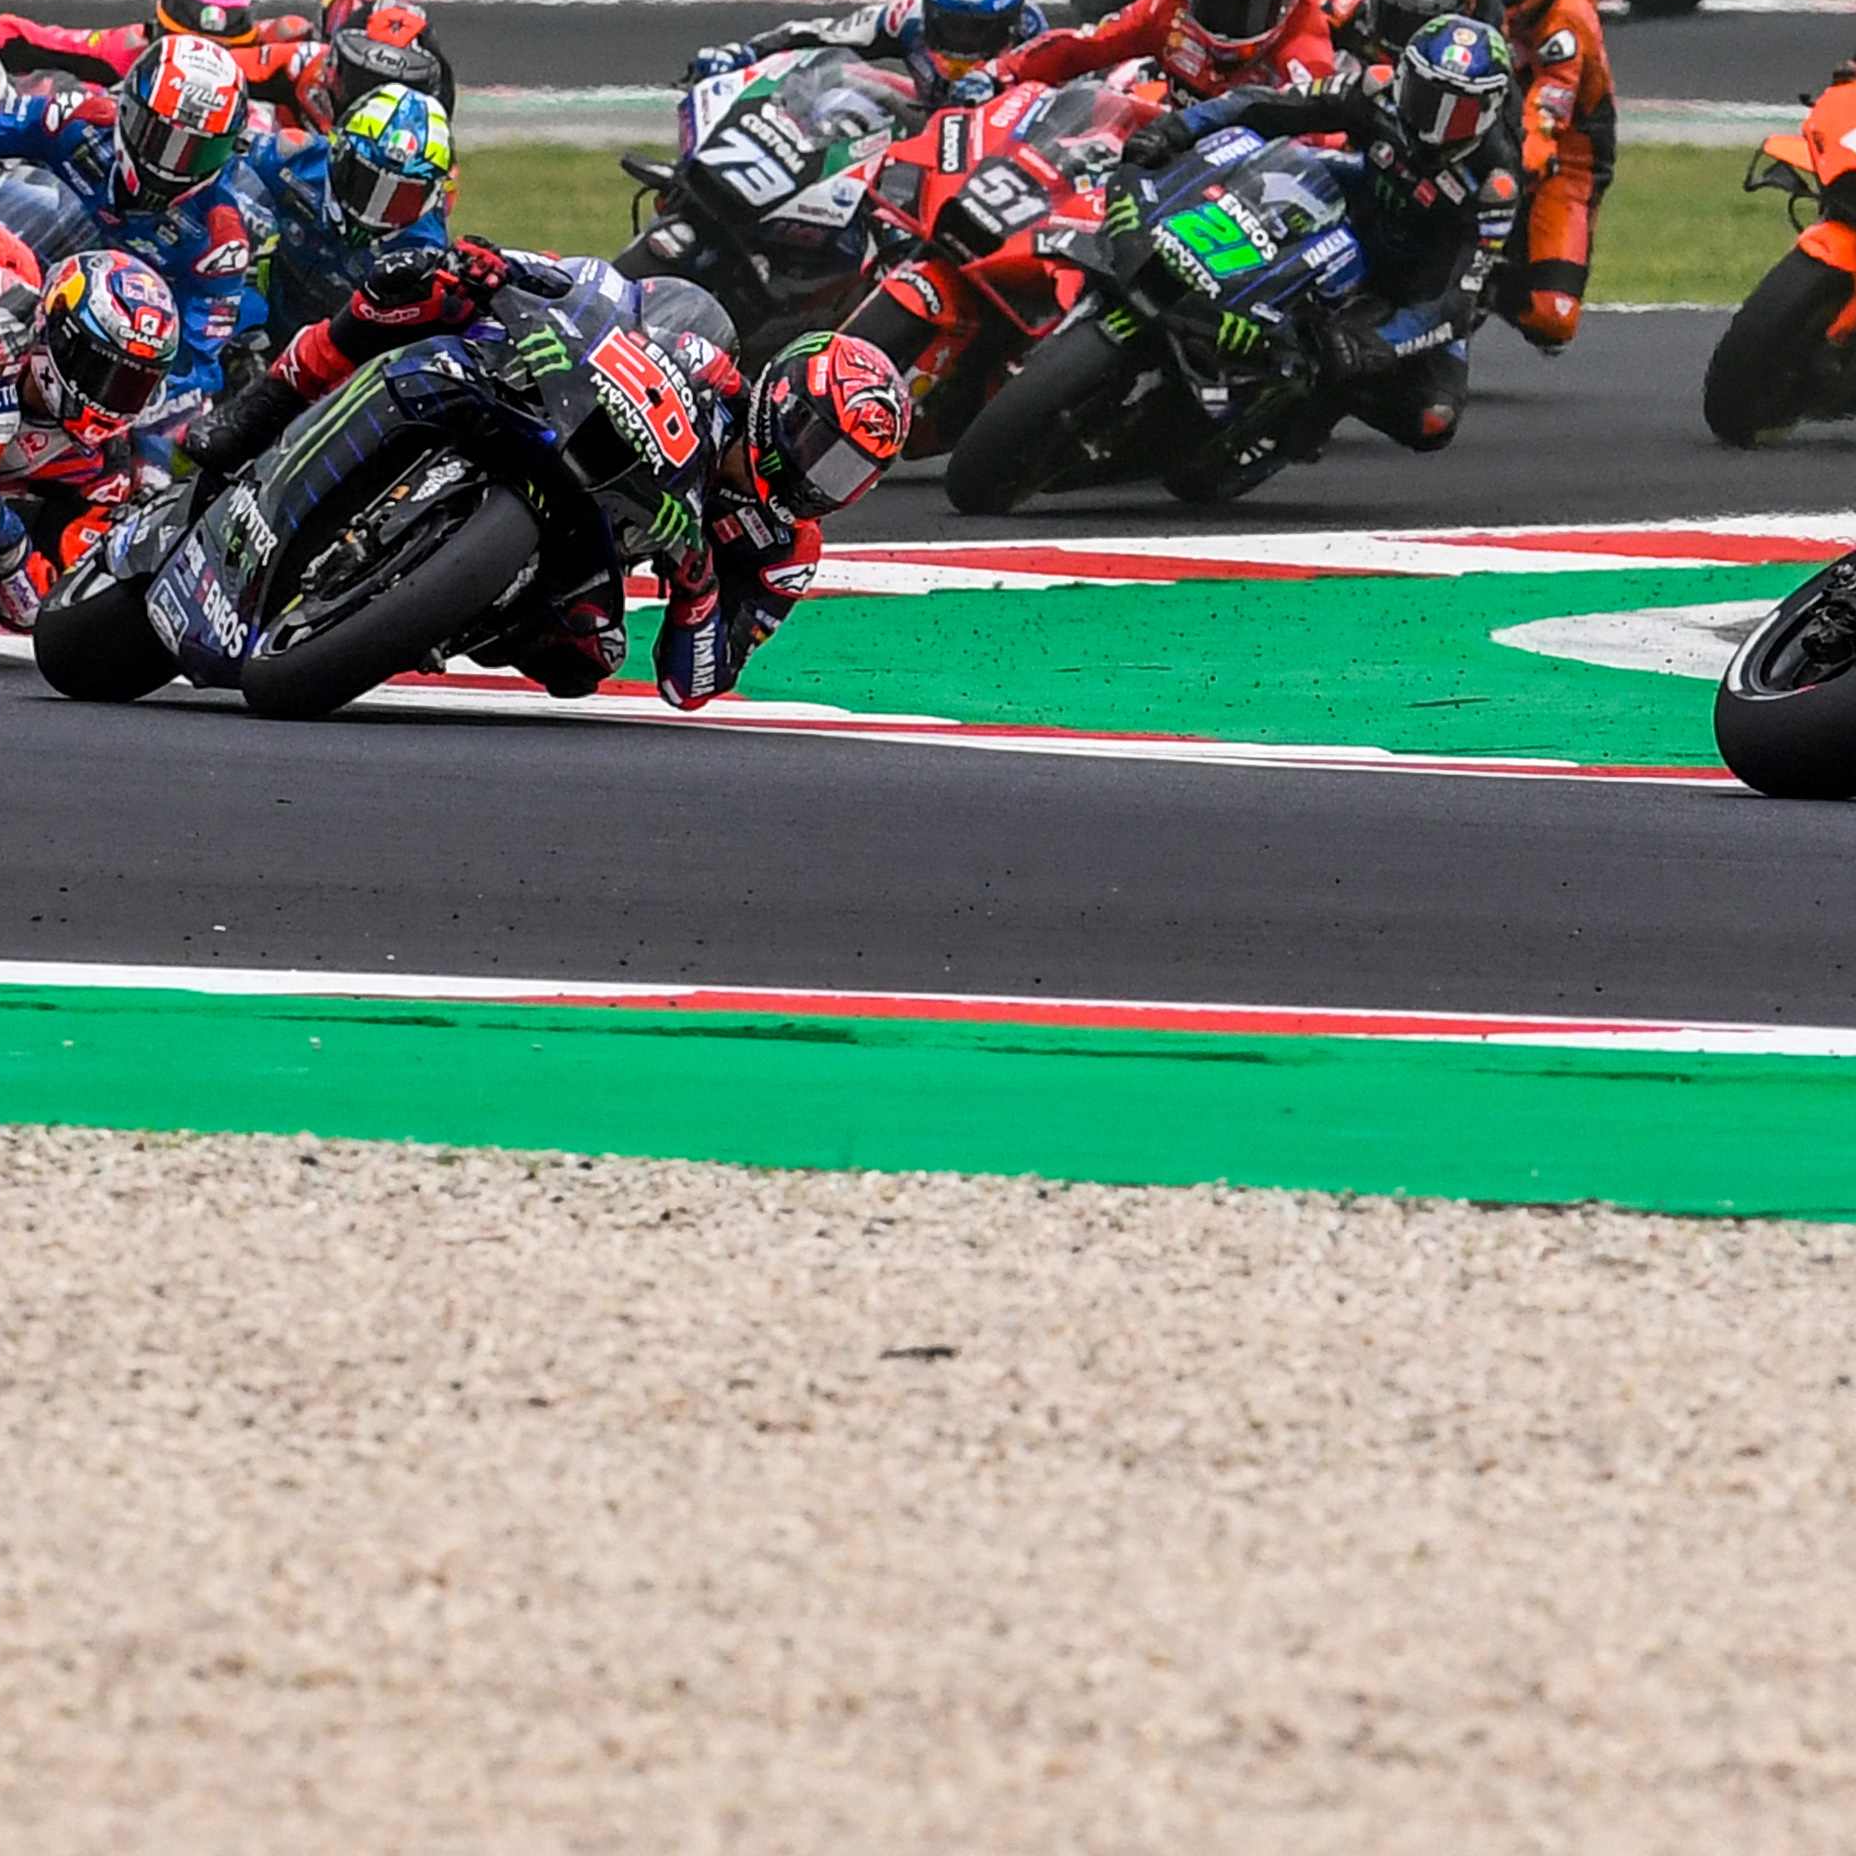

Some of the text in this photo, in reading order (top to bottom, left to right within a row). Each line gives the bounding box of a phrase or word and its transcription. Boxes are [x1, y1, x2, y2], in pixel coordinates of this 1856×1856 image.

[168, 76, 228, 107] NOLAN
[697, 127, 795, 207] 73
[968, 165, 1046, 226] 51
[1160, 202, 1266, 278] 21
[1216, 193, 1278, 262] ENEOS
[587, 325, 701, 469] 20
[625, 342, 697, 424] ENEOS
[589, 371, 665, 477] MONSTER
[202, 579, 248, 659] ENEOS
[691, 621, 716, 698] YAMAHA
